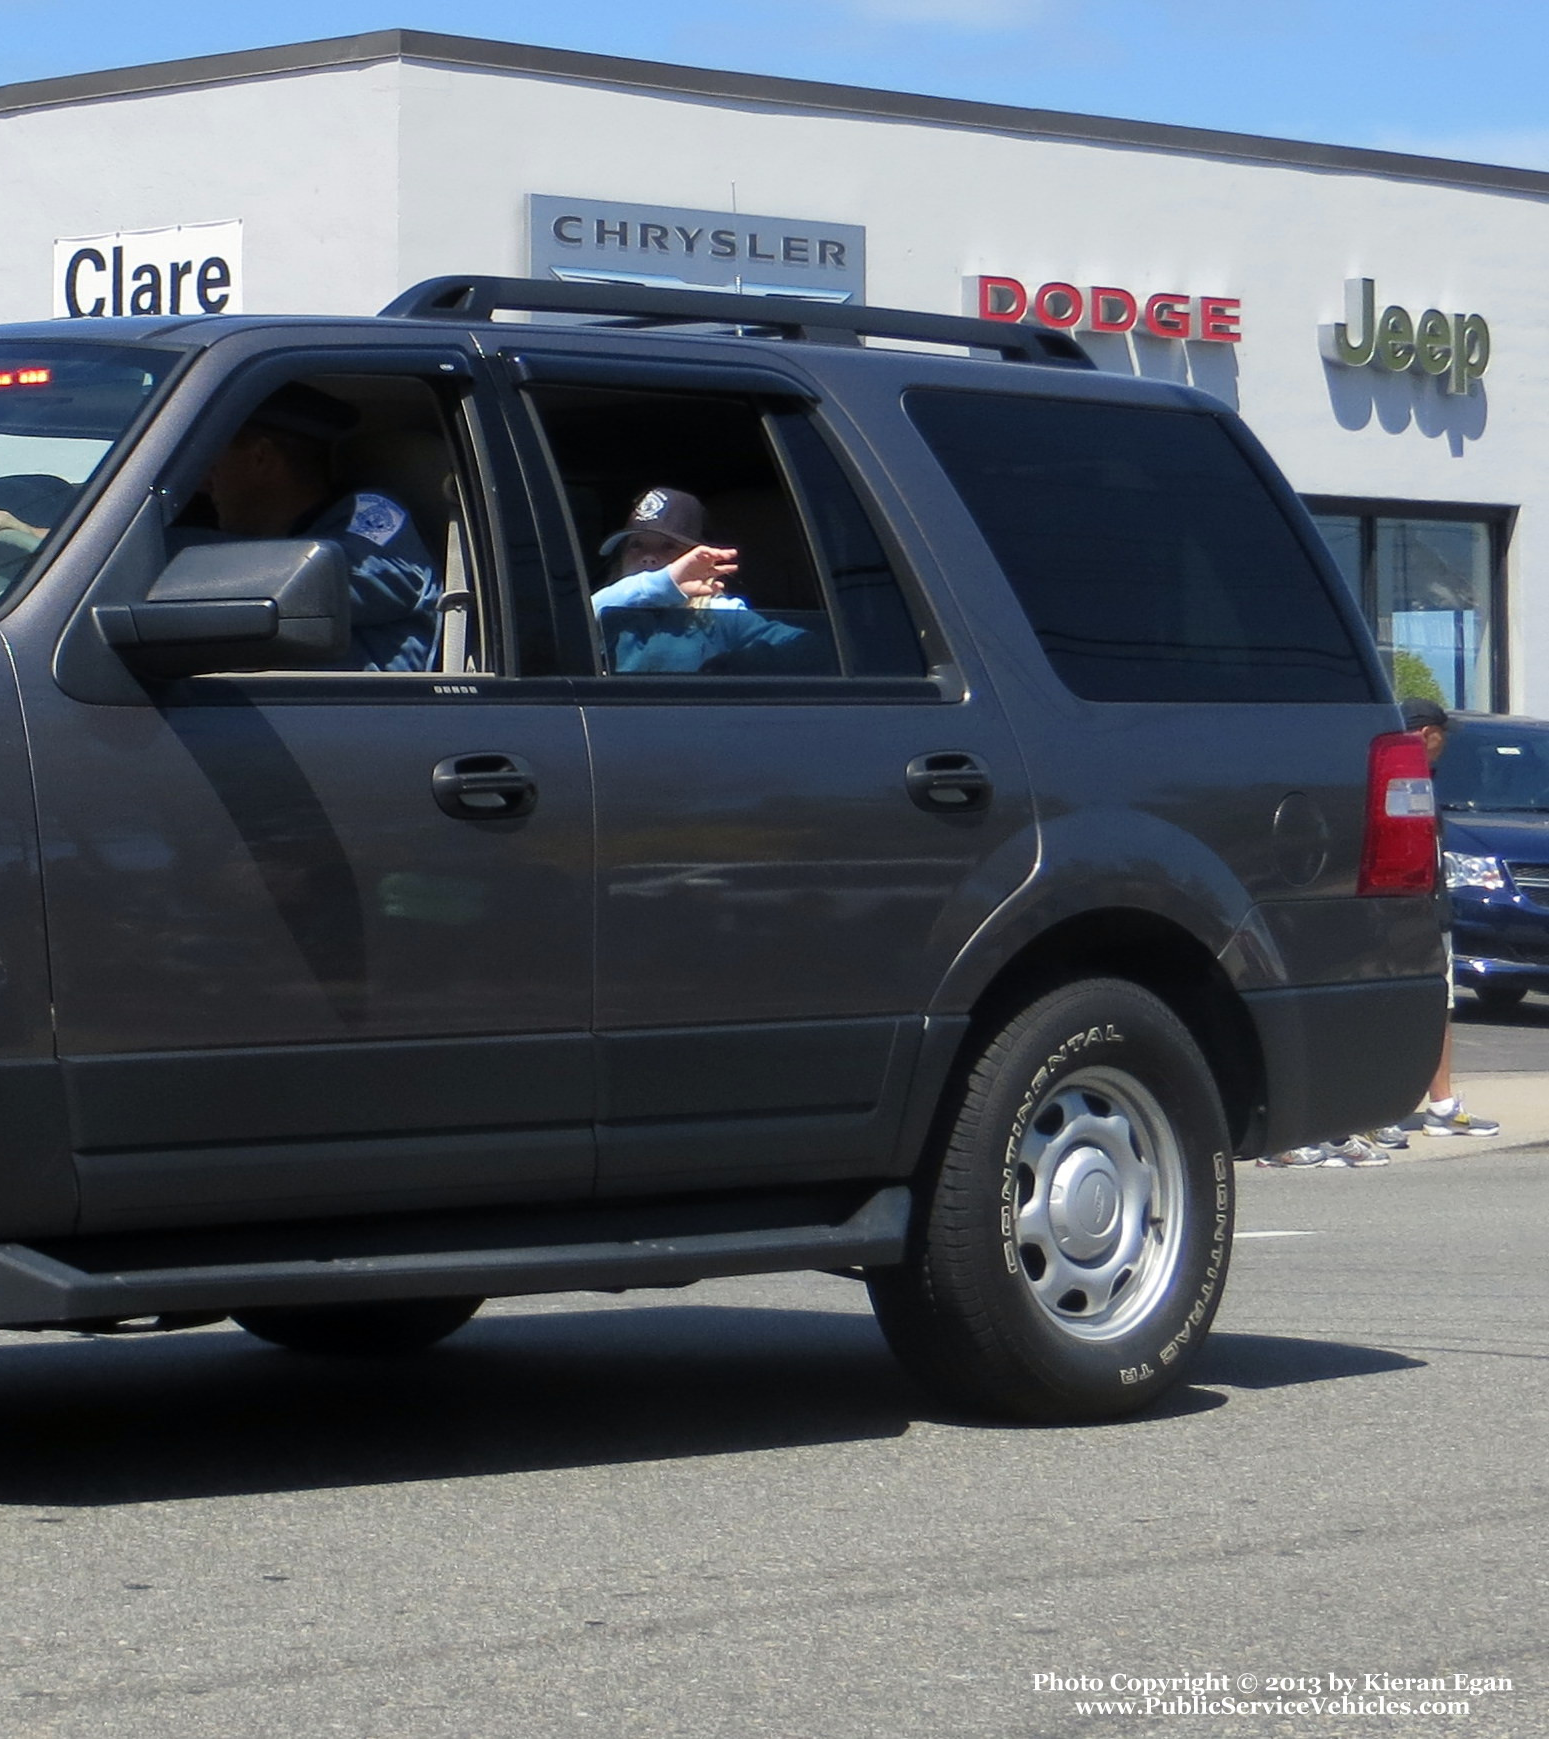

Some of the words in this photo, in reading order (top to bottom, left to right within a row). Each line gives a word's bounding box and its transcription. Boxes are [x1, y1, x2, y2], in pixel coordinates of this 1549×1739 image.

[551, 214, 848, 268] CHRYSLER
[65, 245, 231, 318] Clare
[972, 274, 1242, 343] DODGE
[1323, 276, 1491, 395] Jeep
[1120, 1362, 1155, 1386] TR
